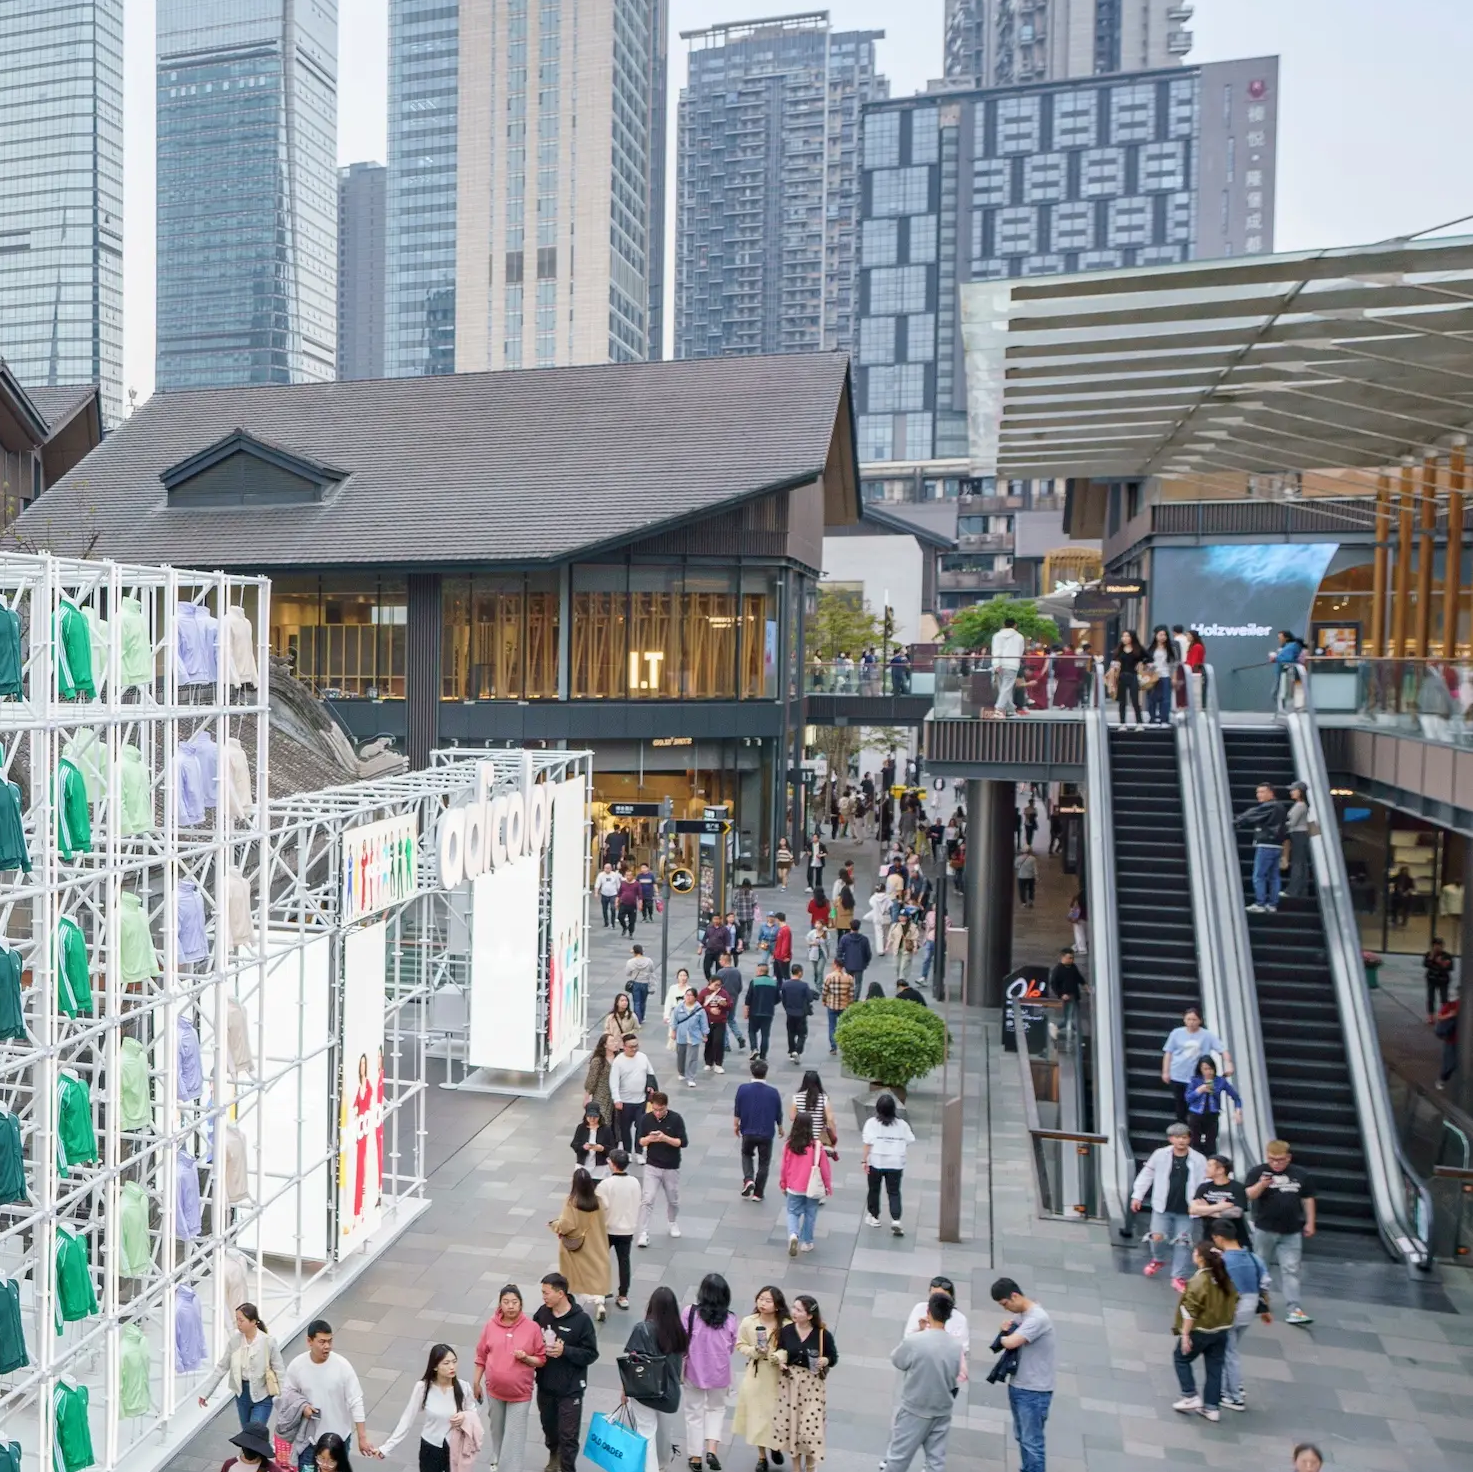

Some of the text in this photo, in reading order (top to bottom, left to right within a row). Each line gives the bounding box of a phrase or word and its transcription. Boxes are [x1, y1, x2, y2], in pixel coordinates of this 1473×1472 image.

[629, 651, 664, 689] I.T
[436, 749, 556, 890] adicolor
[591, 1433, 624, 1459] OLD ORDER
